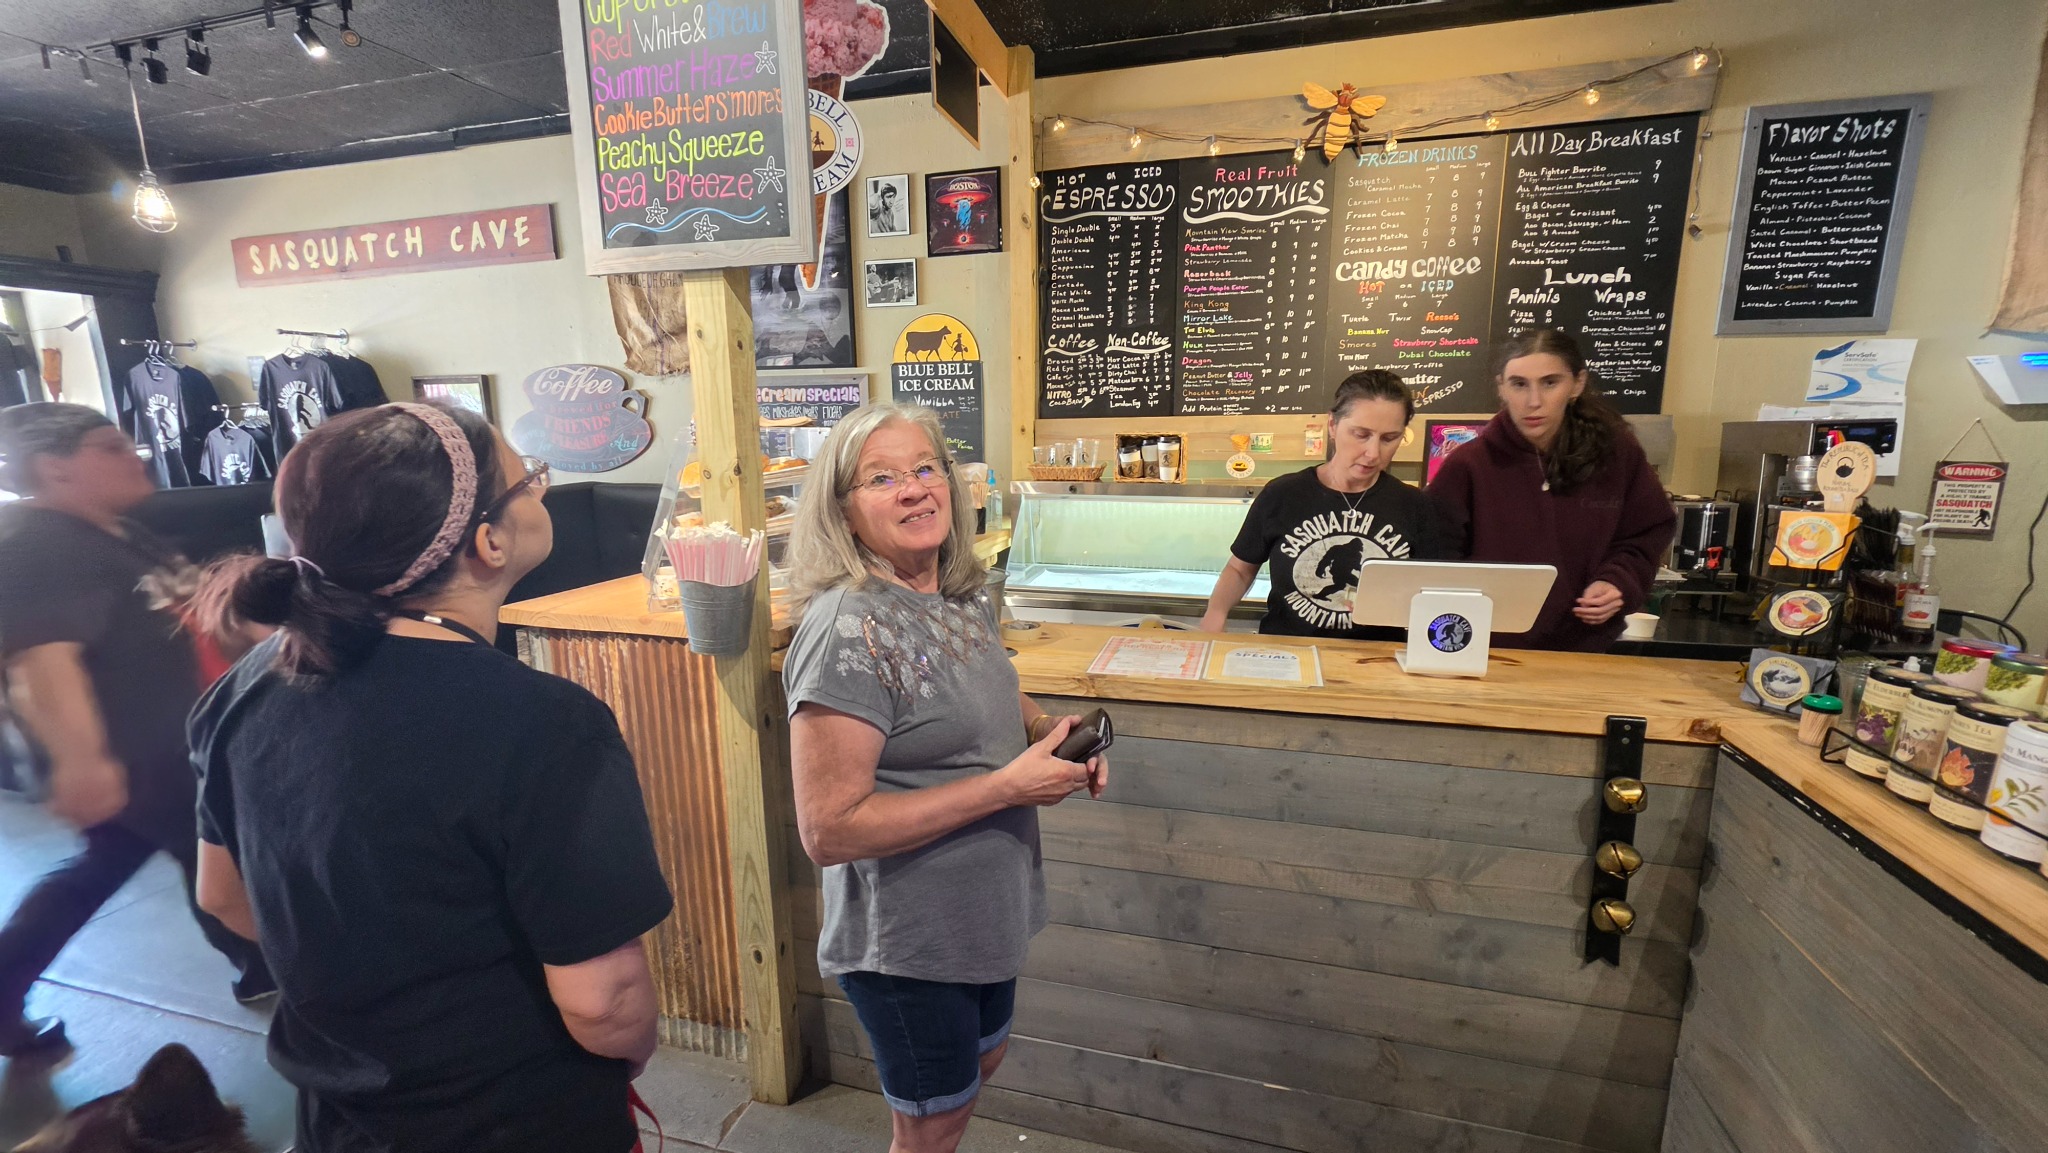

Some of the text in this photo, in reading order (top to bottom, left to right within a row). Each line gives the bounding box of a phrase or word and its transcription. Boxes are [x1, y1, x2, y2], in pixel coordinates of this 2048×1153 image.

[590, 19, 631, 64] Red
[707, 2, 766, 40] Brew
[593, 47, 755, 103] Summer Haze
[1768, 117, 1897, 147] Flavor Shots
[1512, 128, 1682, 157] All Day Breakfast
[597, 129, 764, 182] Peachy Squeeze
[1358, 145, 1478, 167] FROZEN DRINKS
[815, 152, 855, 191] EAM
[1057, 167, 1162, 186] HOT OR ICED
[1216, 164, 1298, 182] Real Fruit
[1540, 168, 1570, 177] Fighter
[1348, 177, 1391, 188] Sasquatch
[1534, 180, 1612, 192] American Breakfast
[601, 169, 753, 212] Sea Breeze
[1053, 184, 1163, 210] ESPRESSO
[1190, 179, 1324, 212] SMOOTHIES
[1761, 186, 1874, 199] Peppermint Lavender
[1516, 202, 1530, 212] Egg
[1753, 203, 1789, 214] English
[1830, 199, 1864, 208] Butter
[1346, 211, 1376, 220] Frozen
[1525, 209, 1616, 220] Bagel Croissant
[1760, 215, 1832, 225] Almond Pistachio
[1052, 224, 1100, 237] Single Double
[1345, 224, 1376, 232] Frozen
[250, 216, 530, 274] SASQUATCH CAVE
[1051, 237, 1073, 245] Double
[1344, 236, 1377, 244] Frozen
[1512, 241, 1534, 249] Bagel
[1184, 244, 1200, 252] Pink
[1343, 247, 1375, 256] Cookies
[1841, 248, 1877, 256] Pumpkin
[1509, 258, 1545, 266] Avocado
[1544, 267, 1632, 286] Lunch
[1359, 281, 1385, 294] HOT
[1421, 280, 1454, 292] ICED
[1508, 287, 1647, 308] Paninis Wraps
[1184, 300, 1229, 309] King Kong
[1426, 312, 1459, 322] Reese's
[1048, 333, 1097, 348] Coffee
[1107, 331, 1170, 347] Non-Coffee
[1339, 337, 1478, 349] S'mores Strawberry Shortcake
[1182, 357, 1212, 365] Dragon
[1399, 351, 1424, 359] Dubai
[1585, 359, 1631, 367] Vegetarian
[899, 363, 973, 377] BLUE BELL
[1234, 371, 1253, 379] Jelly
[534, 366, 613, 401] Coffee
[899, 378, 975, 392] ICE CREAM
[1047, 391, 1072, 399] NITRO
[1414, 380, 1463, 408] ESPRESSO
[545, 415, 611, 433] FRIENDS
[610, 433, 639, 451] And
[609, 457, 621, 467] all
[1944, 467, 1997, 476] WARNING
[1936, 499, 1993, 508] SASQUATCH
[1280, 510, 1375, 558] SASQUATCH
[1284, 591, 1352, 629] MOUNTAIN
[1430, 615, 1471, 632] SASQUATCH CAVE
[1235, 652, 1297, 661] SPECIALS
[2017, 747, 2048, 763] MANG
